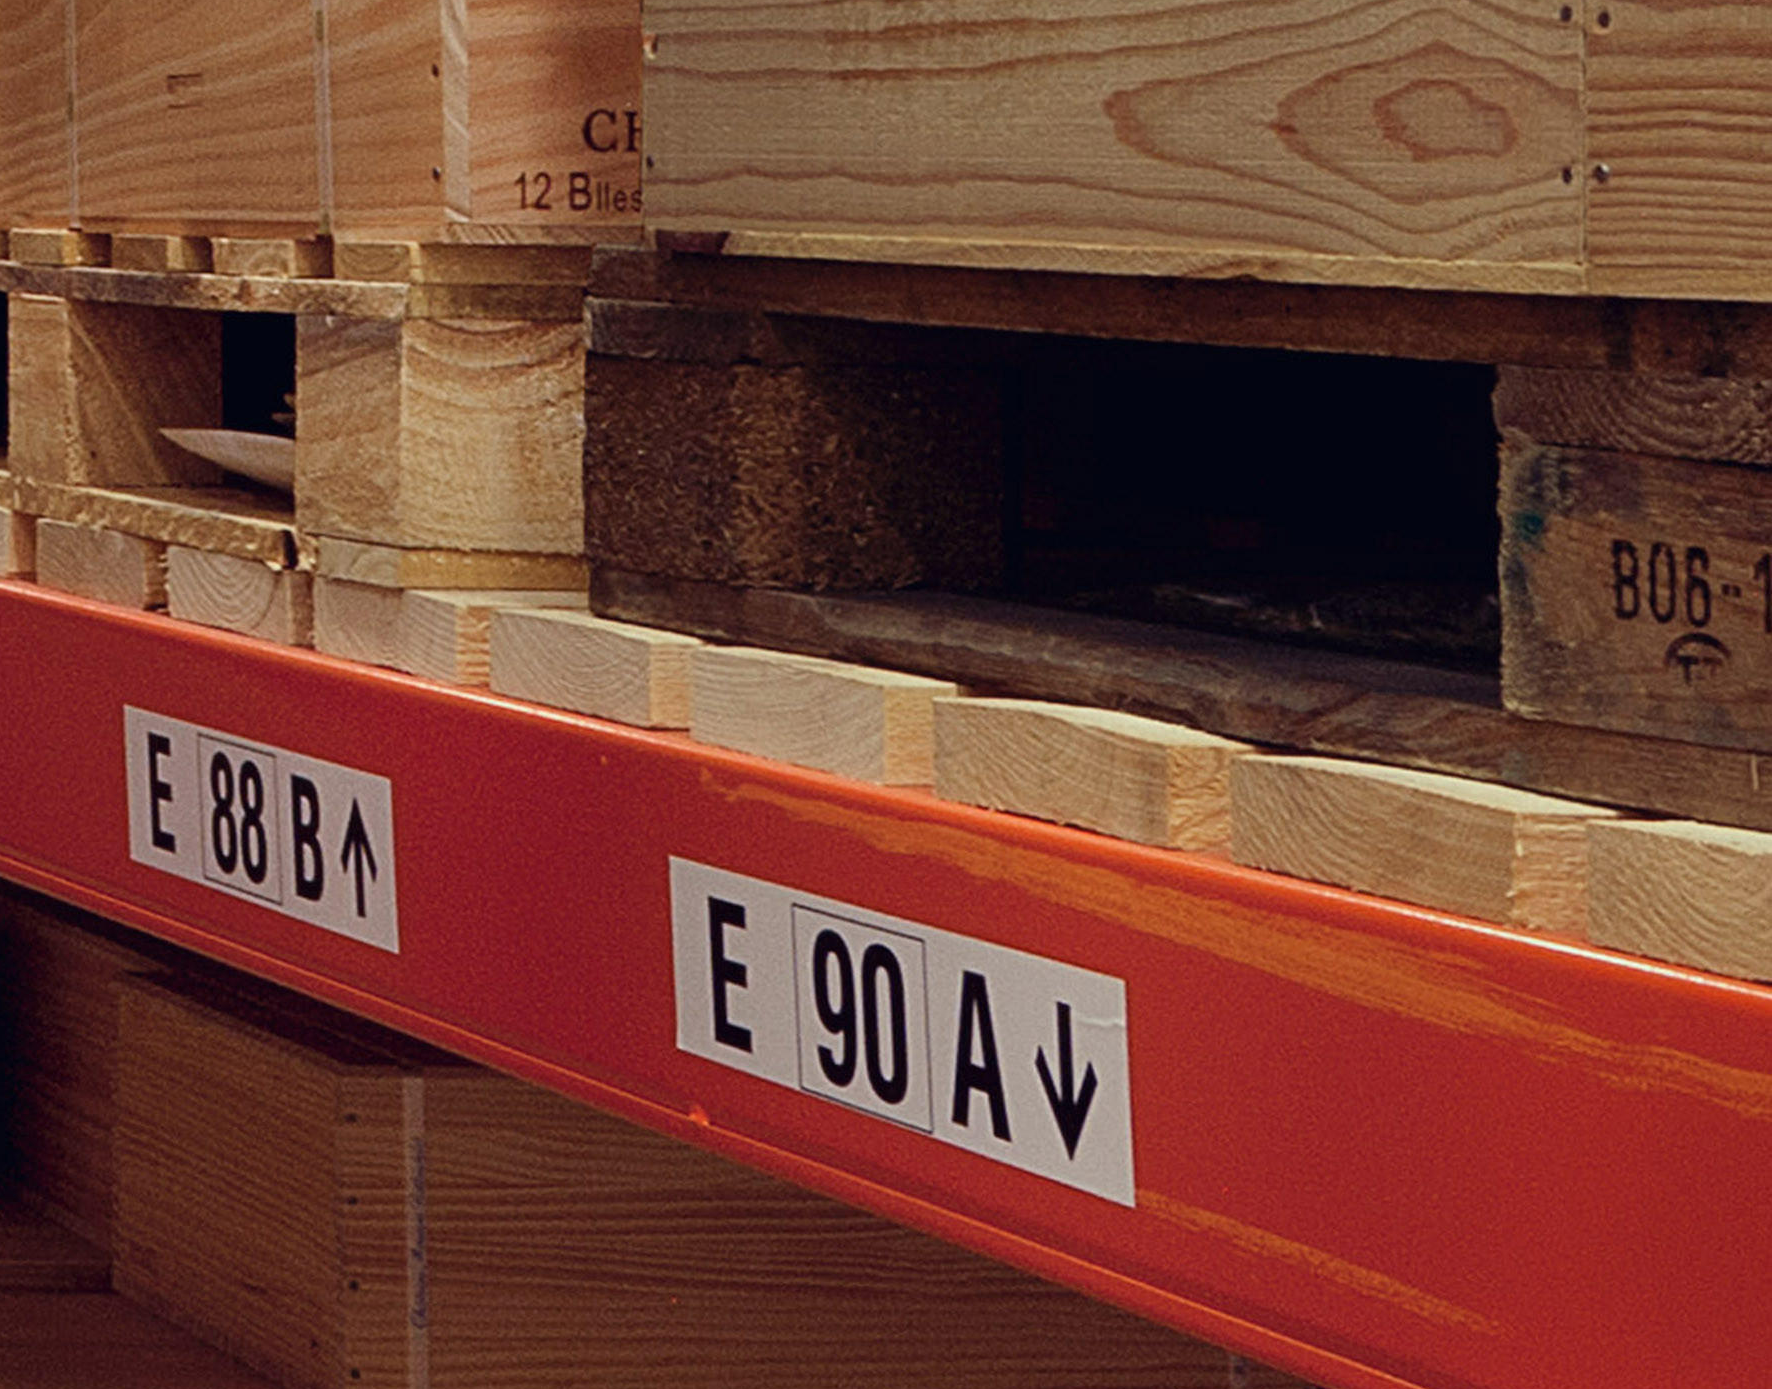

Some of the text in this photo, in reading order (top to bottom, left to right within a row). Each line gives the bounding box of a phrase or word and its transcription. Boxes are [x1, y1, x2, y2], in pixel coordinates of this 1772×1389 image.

[516, 172, 551, 212] 12
[145, 732, 325, 903] E 88 B
[706, 894, 1014, 1144] E 90 A
